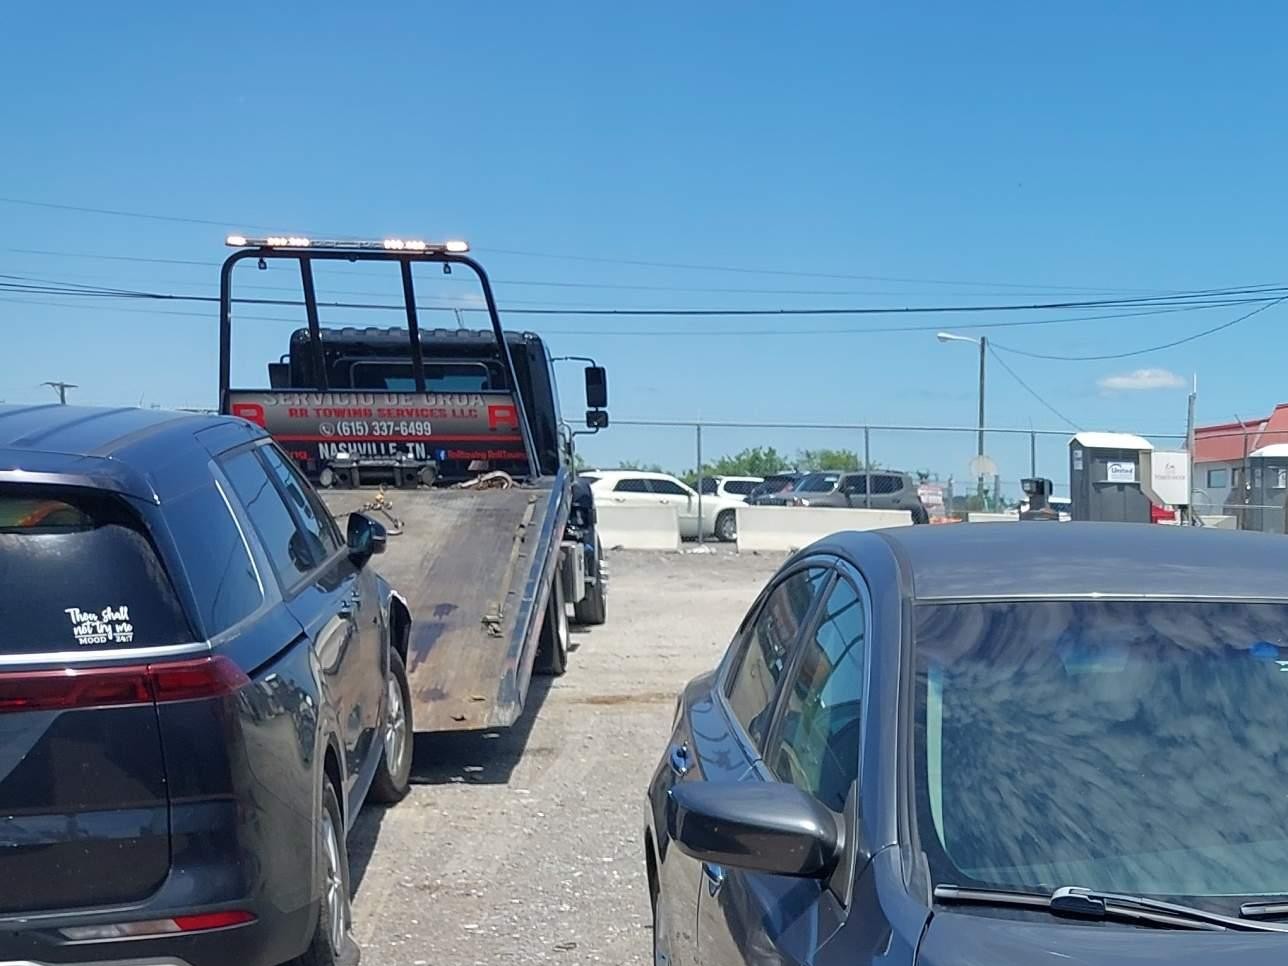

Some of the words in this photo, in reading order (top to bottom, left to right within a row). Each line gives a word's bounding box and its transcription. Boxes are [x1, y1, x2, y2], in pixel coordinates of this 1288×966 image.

[288, 408, 309, 418] RR
[377, 408, 448, 418] SERVICES
[451, 408, 479, 418] LLC
[336, 421, 369, 436] (615)
[372, 421, 432, 436] 337-6499
[64, 607, 98, 625] Thou
[102, 605, 130, 623] shall
[73, 620, 93, 636] not
[94, 620, 113, 640] try
[79, 636, 107, 645] MOOD
